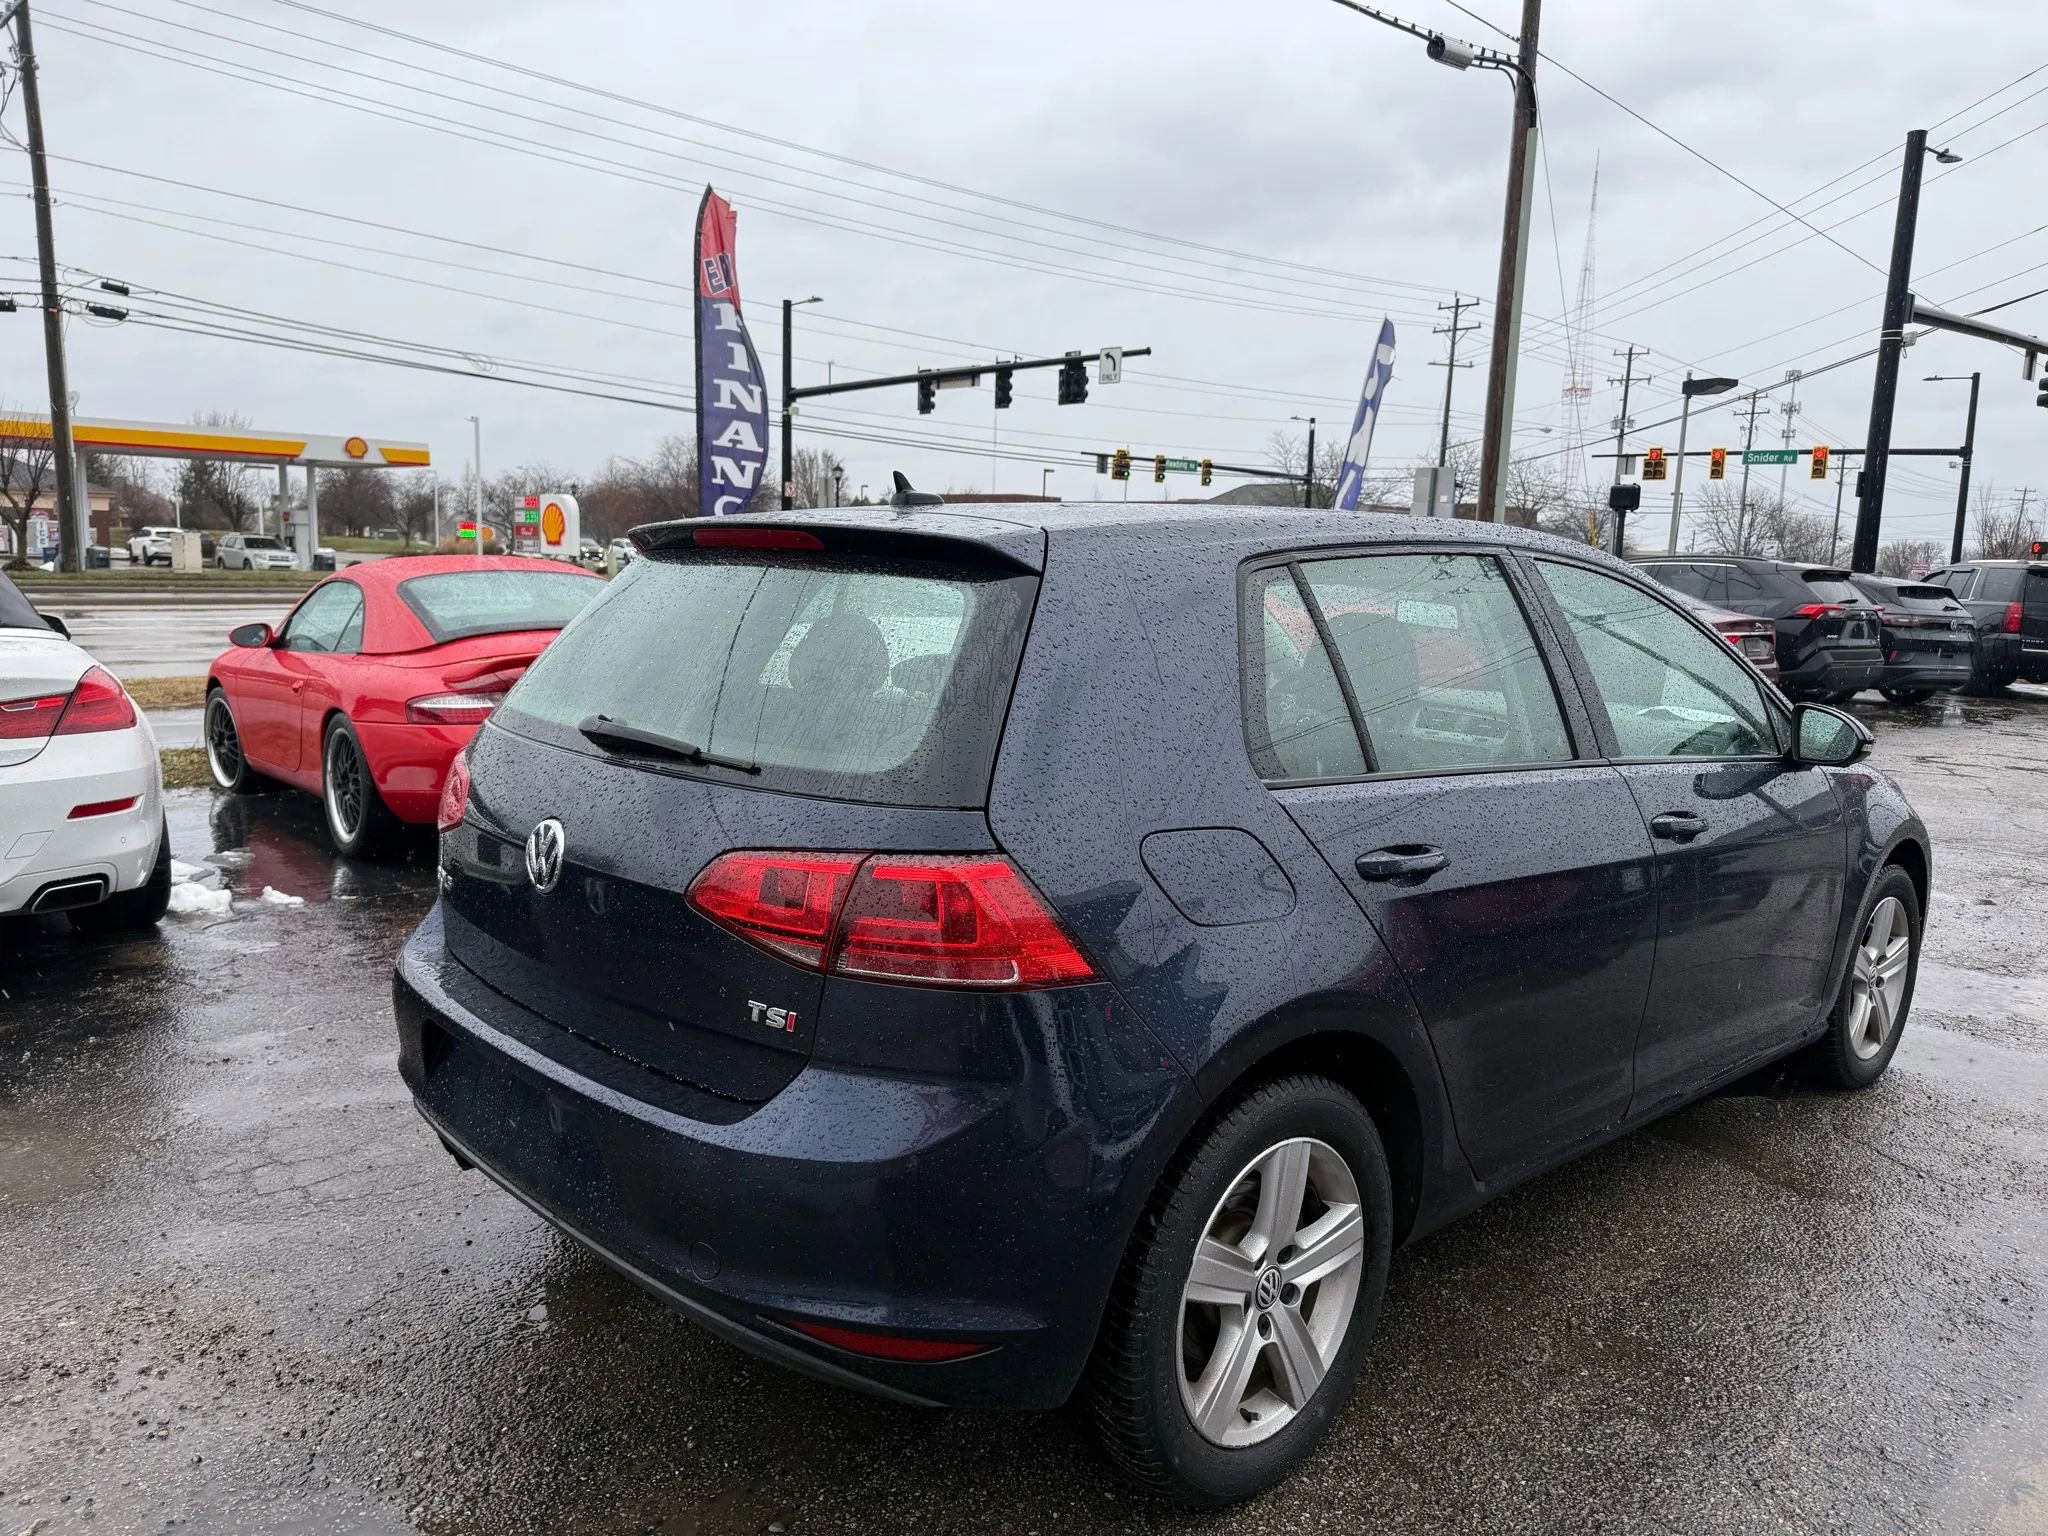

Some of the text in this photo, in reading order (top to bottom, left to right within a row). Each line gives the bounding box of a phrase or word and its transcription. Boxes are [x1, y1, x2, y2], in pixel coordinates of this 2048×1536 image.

[1101, 372, 1118, 382] ONLY
[1747, 452, 1779, 463] Snider
[747, 999, 798, 1033] TSI
